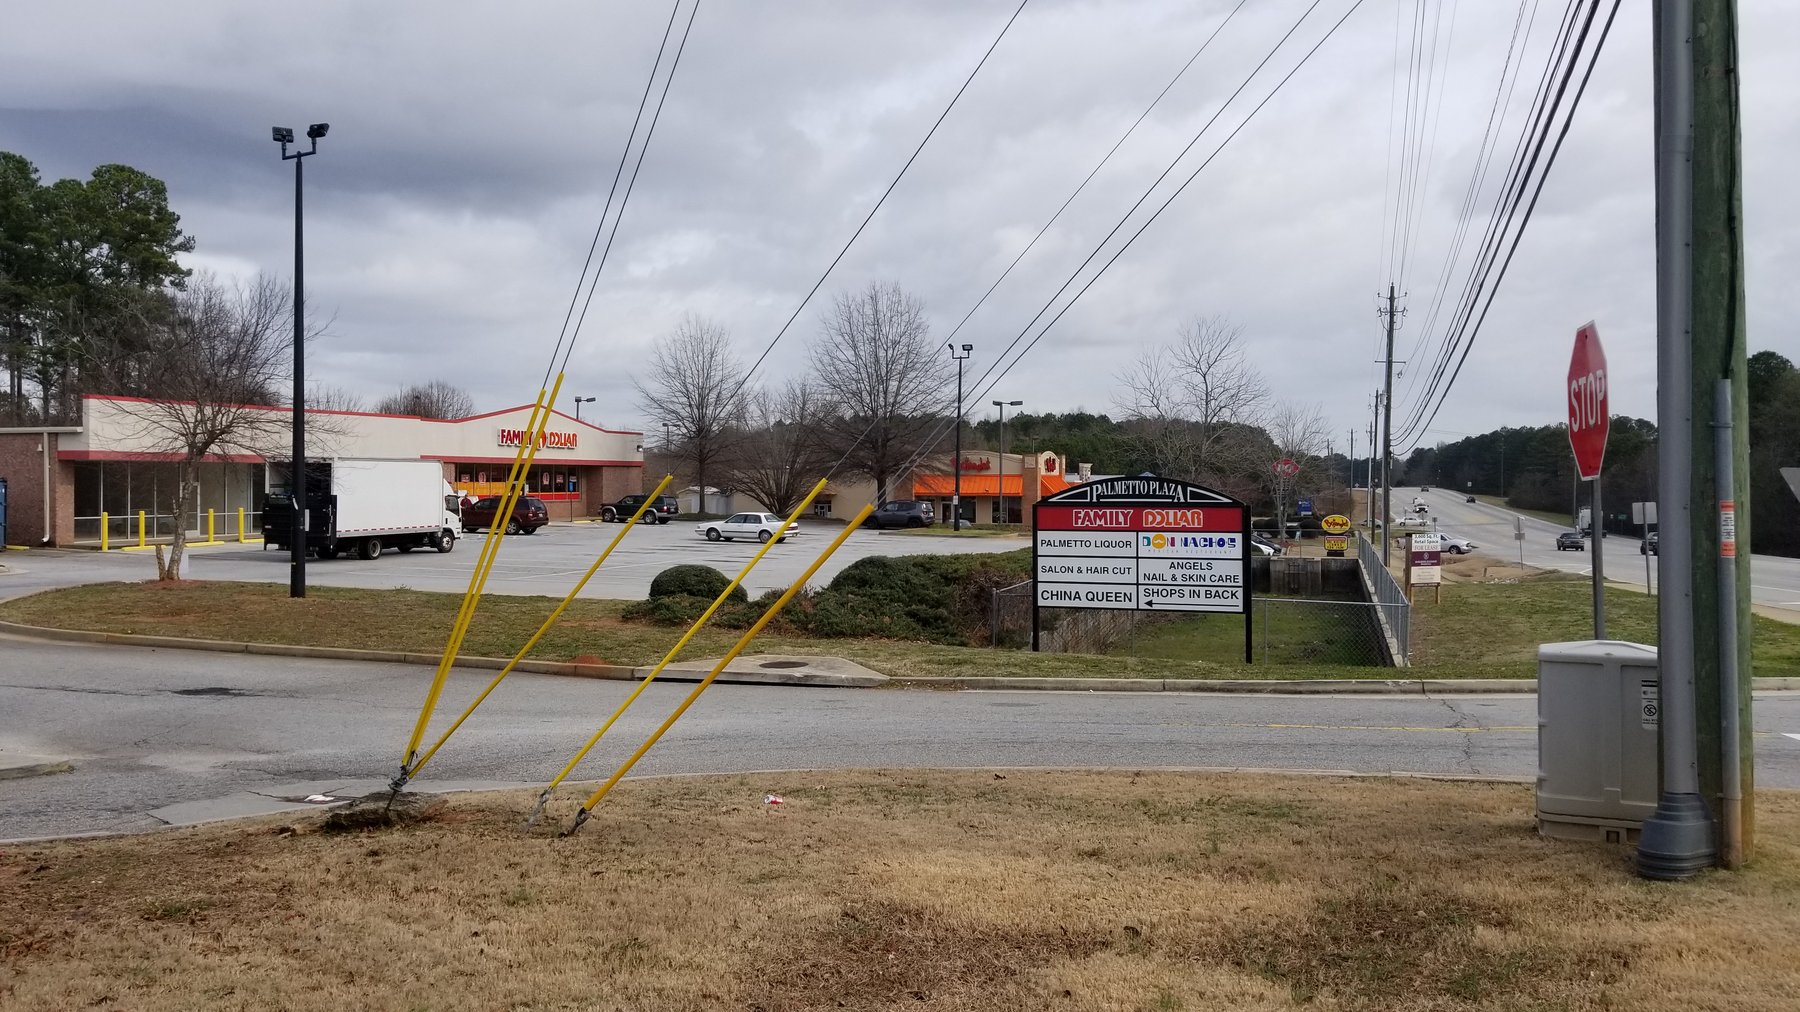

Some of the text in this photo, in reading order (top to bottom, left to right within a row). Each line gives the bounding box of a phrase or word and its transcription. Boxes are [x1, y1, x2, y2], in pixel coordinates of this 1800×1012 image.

[1570, 369, 1605, 432] STOP
[548, 431, 578, 447] DOLLAR
[1092, 480, 1184, 503] PALMETTO PLAZA
[1073, 509, 1203, 527] FAMILY DOLLAR
[1040, 539, 1132, 549] PALMETTO LIQUOR
[1142, 534, 1176, 549] DON
[1040, 565, 1132, 575] SALON & HAIR CUT
[1169, 561, 1214, 571] ANGELS
[1143, 573, 1240, 583] NAIL & SKIN CARE
[1041, 590, 1132, 602] CHINA QUEEN
[1143, 587, 1239, 600] SHOPS IN BACK
